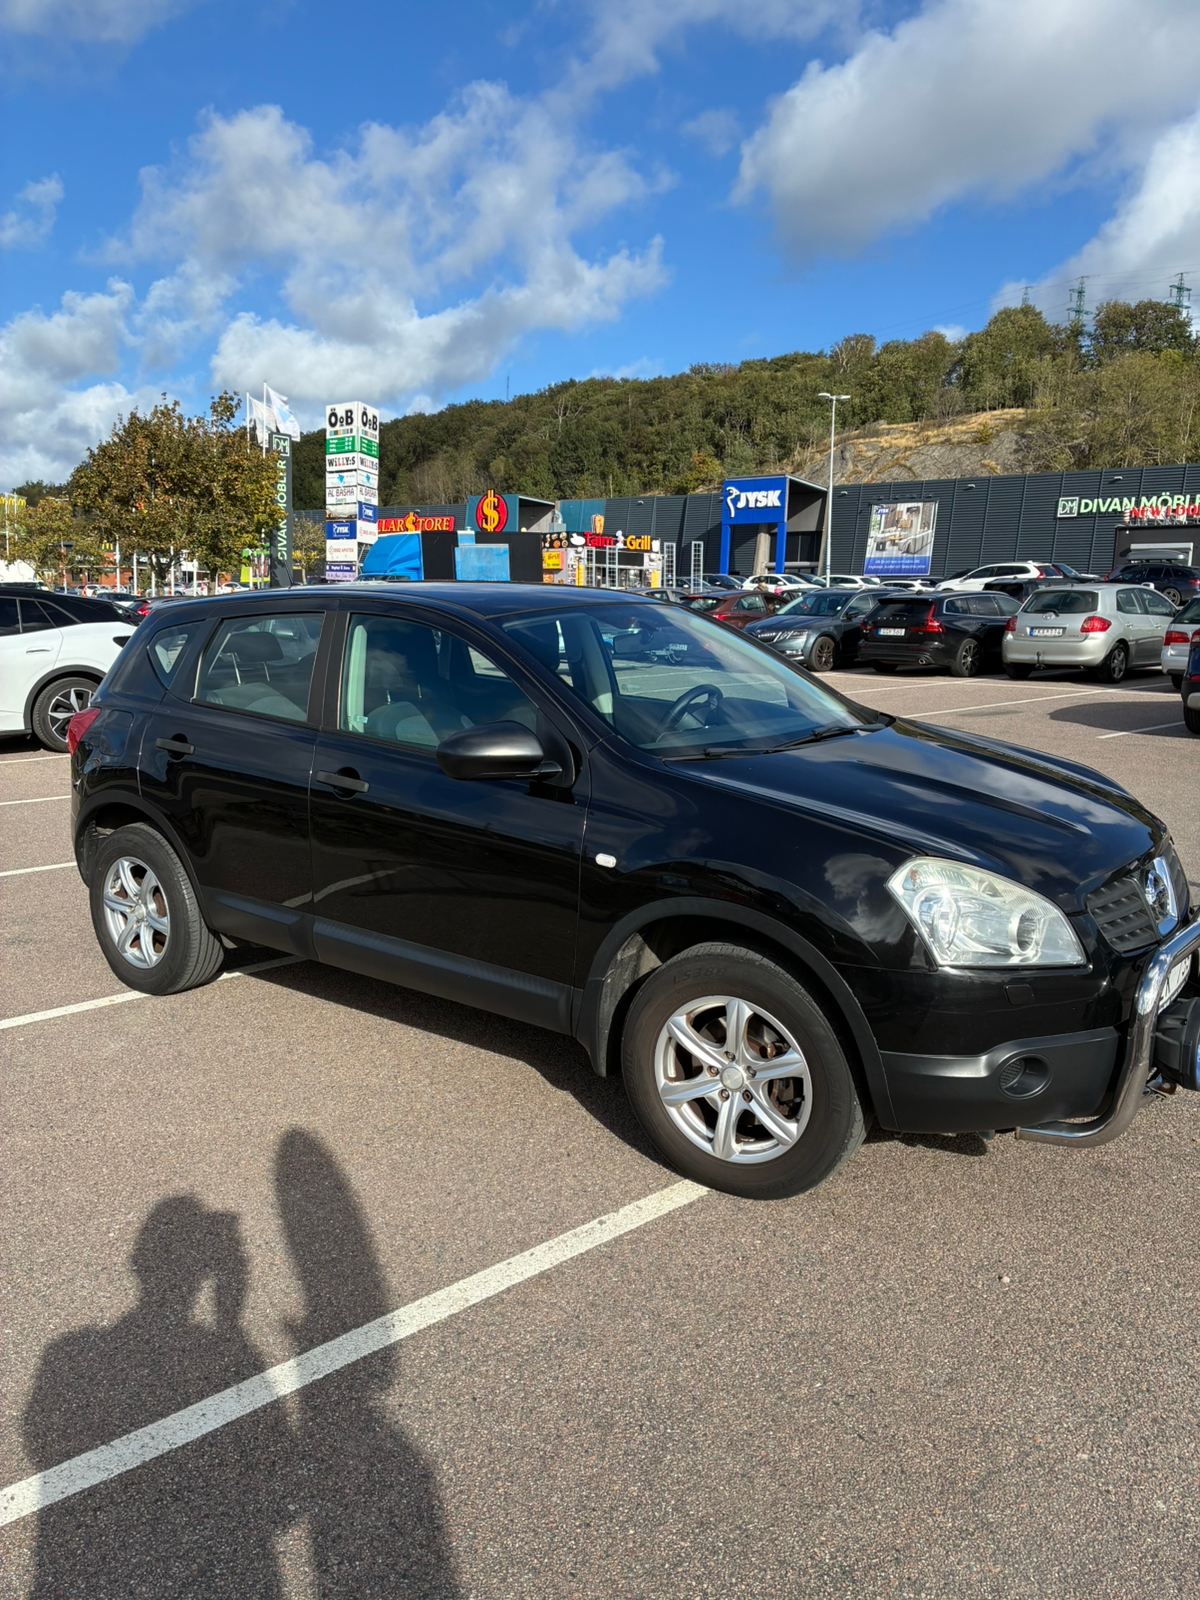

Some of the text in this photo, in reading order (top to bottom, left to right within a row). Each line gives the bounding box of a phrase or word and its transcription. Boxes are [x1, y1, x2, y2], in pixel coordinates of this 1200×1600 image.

[736, 490, 782, 509] JYSK
[1080, 497, 1135, 513] DIVAN
[626, 535, 651, 551] Grill
